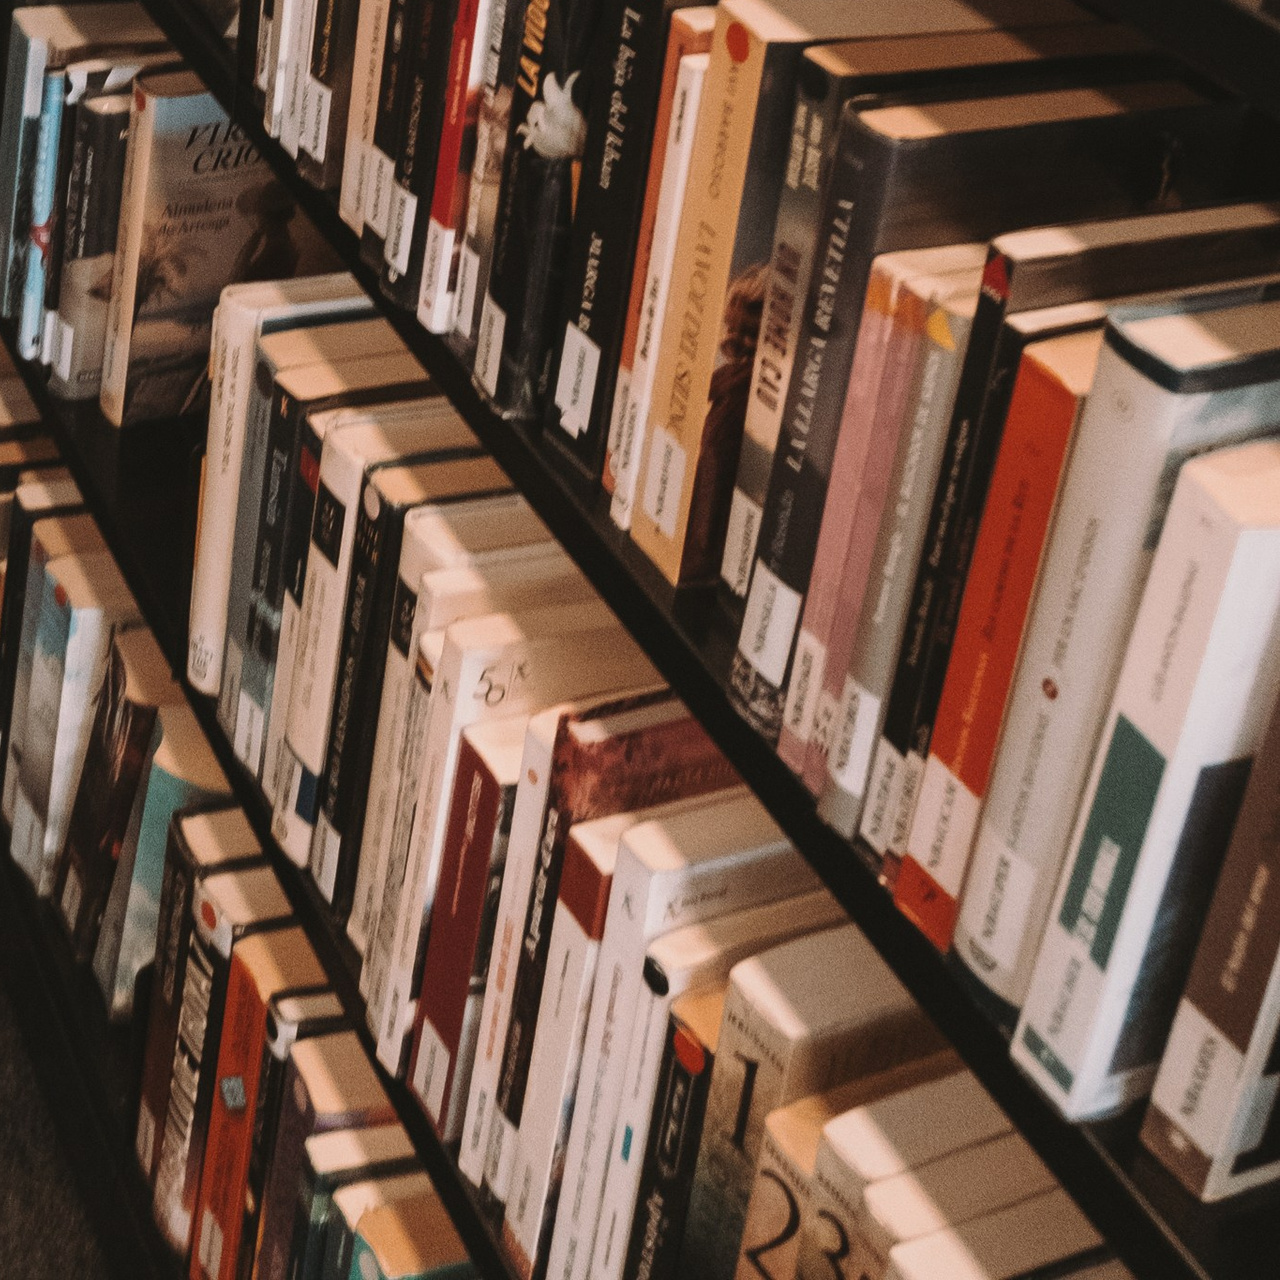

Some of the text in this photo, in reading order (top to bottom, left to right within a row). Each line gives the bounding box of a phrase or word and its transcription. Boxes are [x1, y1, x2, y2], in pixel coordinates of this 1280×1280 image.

[618, 5, 642, 36] La
[515, 58, 542, 97] LA
[608, 42, 636, 86] hija
[605, 89, 630, 130] del
[760, 283, 797, 354] HOME
[750, 356, 785, 412] CAU
